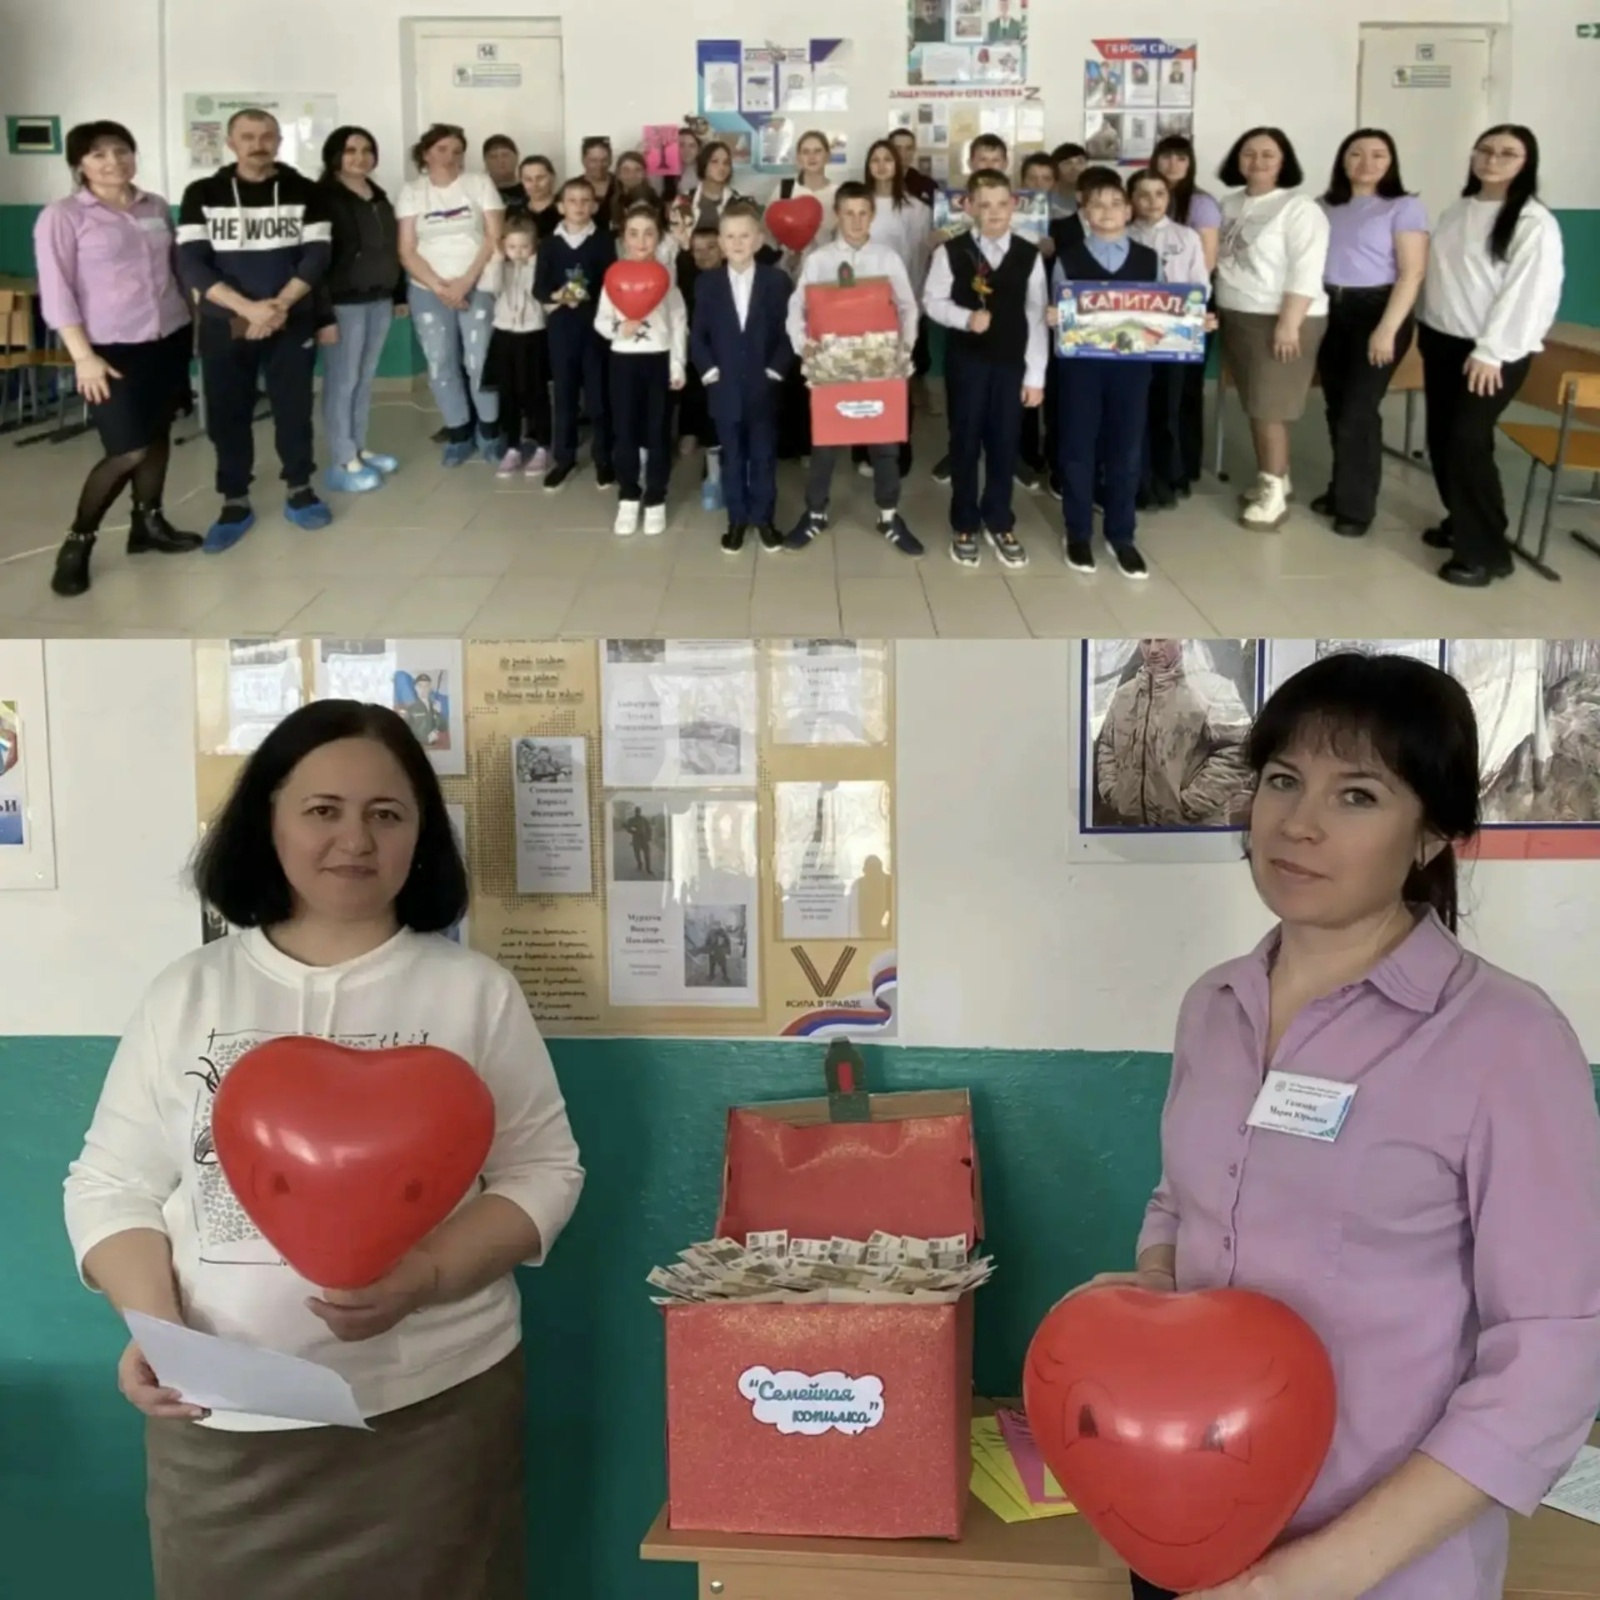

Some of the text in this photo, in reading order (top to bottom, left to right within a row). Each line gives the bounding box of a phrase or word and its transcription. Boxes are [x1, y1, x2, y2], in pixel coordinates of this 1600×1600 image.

[1104, 43, 1147, 54] ГЕРОИ
[207, 217, 239, 240] HE
[1081, 291, 1182, 314] КАПИТАЛ
[827, 1000, 862, 1009] ПРАВДЕ
